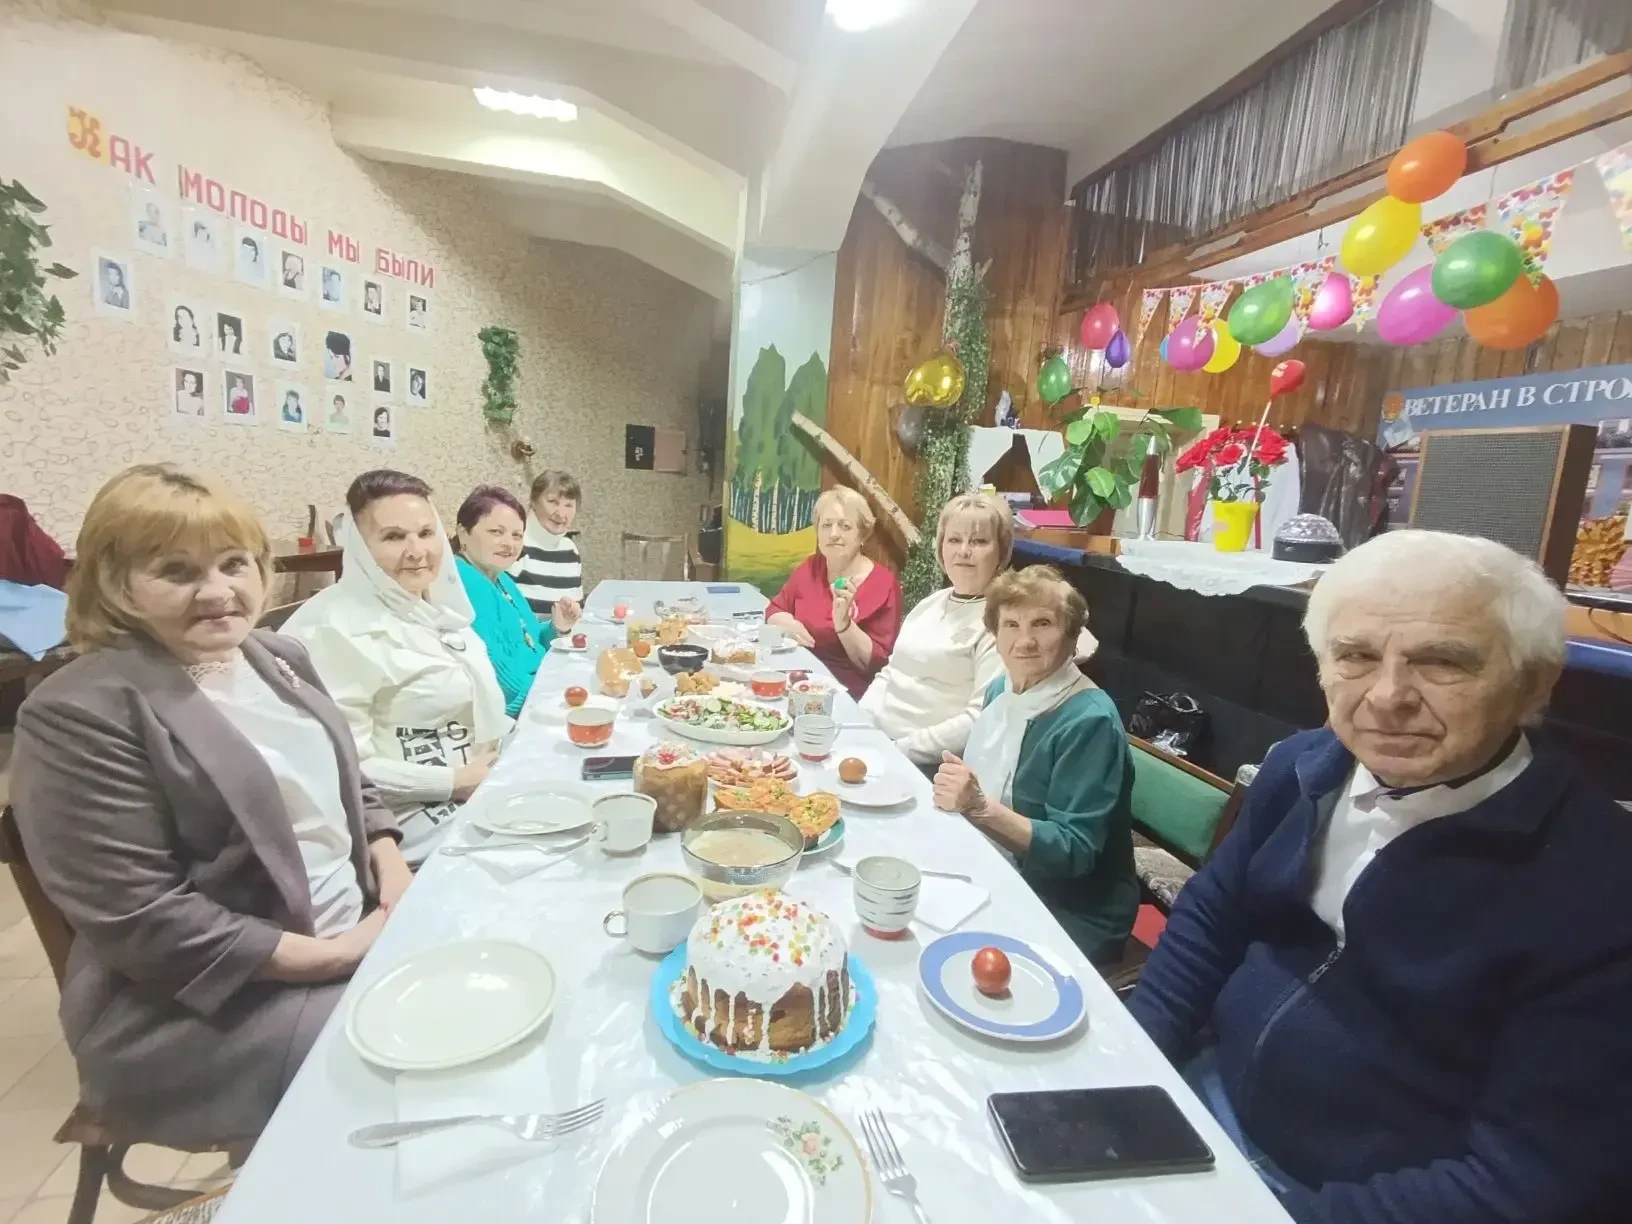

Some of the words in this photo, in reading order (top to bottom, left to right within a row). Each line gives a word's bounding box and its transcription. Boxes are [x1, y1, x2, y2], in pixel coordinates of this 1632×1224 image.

[328, 230, 360, 263] МЫ
[1405, 388, 1511, 416] ВЕТЕРАН
[1516, 386, 1537, 407] В
